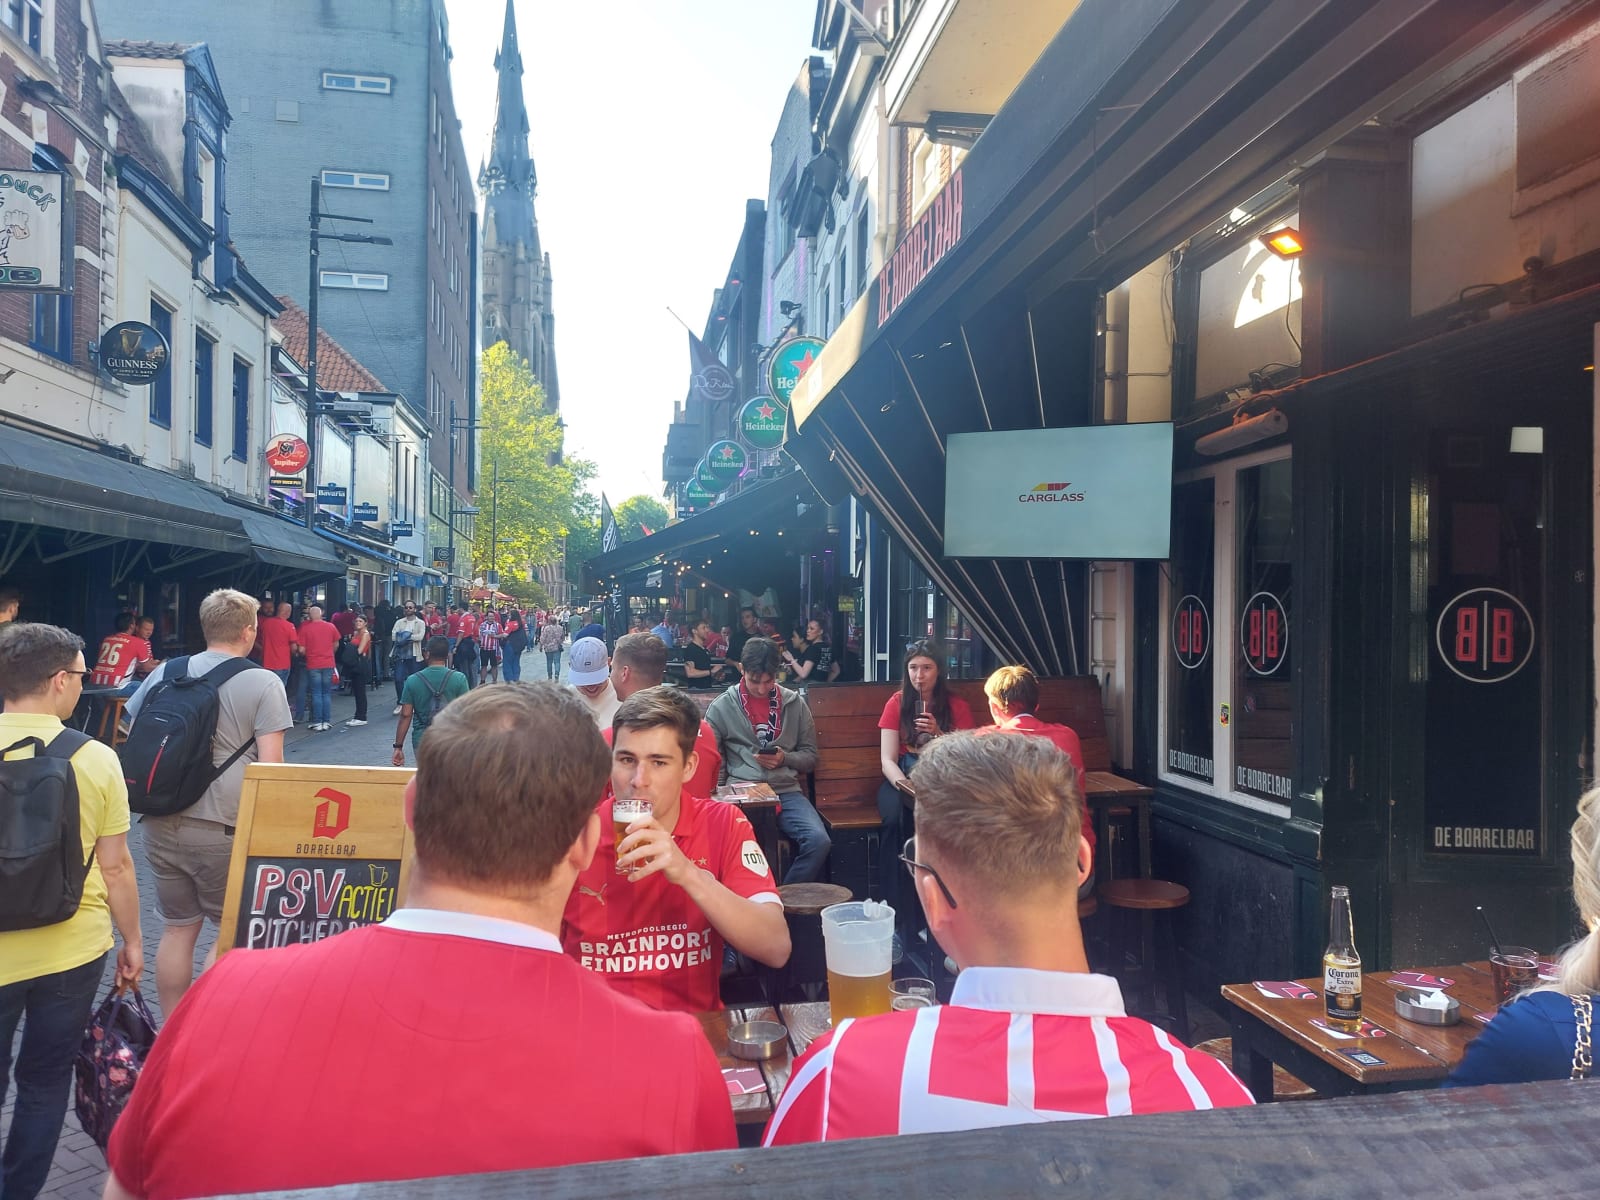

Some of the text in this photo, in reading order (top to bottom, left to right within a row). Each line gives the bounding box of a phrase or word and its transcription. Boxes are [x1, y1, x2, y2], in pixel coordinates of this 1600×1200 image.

[878, 168, 963, 329] DE BORRELBAR
[107, 357, 159, 370] GUINNESS
[318, 489, 346, 497] Bavaria
[1018, 493, 1084, 503] CARGLASS
[98, 642, 123, 666] 26
[1169, 749, 1178, 767] DE
[1237, 765, 1292, 799] DE BORRELBAR
[1434, 826, 1535, 849] DE BORRELBAR
[296, 843, 357, 857] BORRELBAR
[250, 864, 346, 919] PSV
[607, 923, 688, 941] METROPOOLREGIO
[580, 928, 711, 956] BRAINPORT
[581, 945, 712, 973] EINDHOVEN
[1328, 967, 1360, 979] Corona
[1336, 977, 1354, 985] Extra
